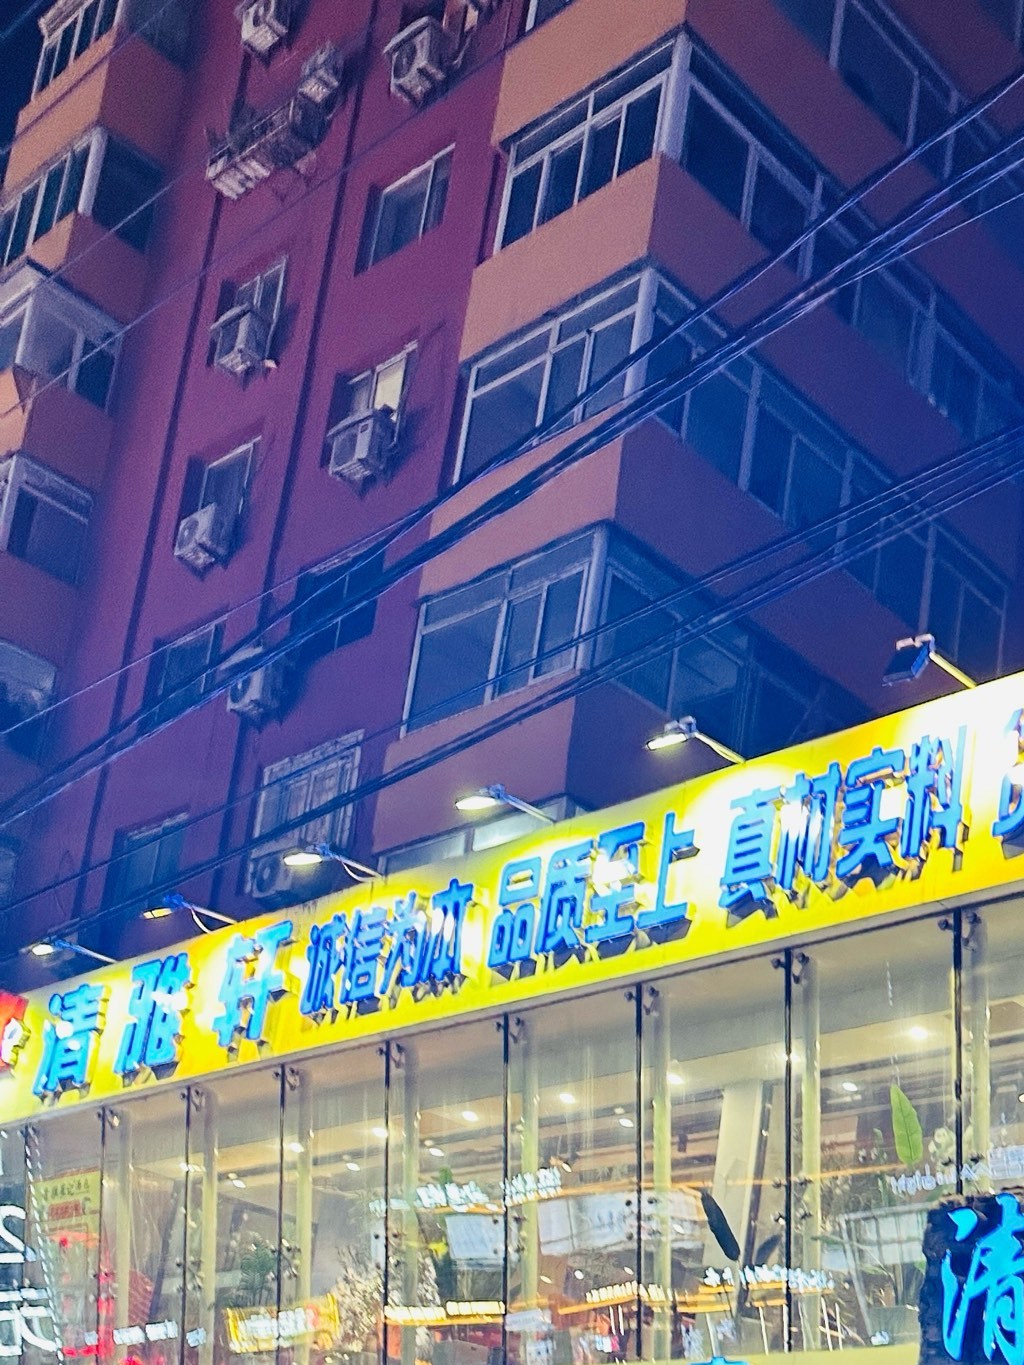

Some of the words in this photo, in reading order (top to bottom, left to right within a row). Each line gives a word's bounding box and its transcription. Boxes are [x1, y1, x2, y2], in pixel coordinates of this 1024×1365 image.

[32, 920, 295, 1096] 清雅轩
[301, 878, 473, 1015] 诚信为本
[488, 812, 696, 969] 品质至上
[717, 725, 968, 902] 真材实料
